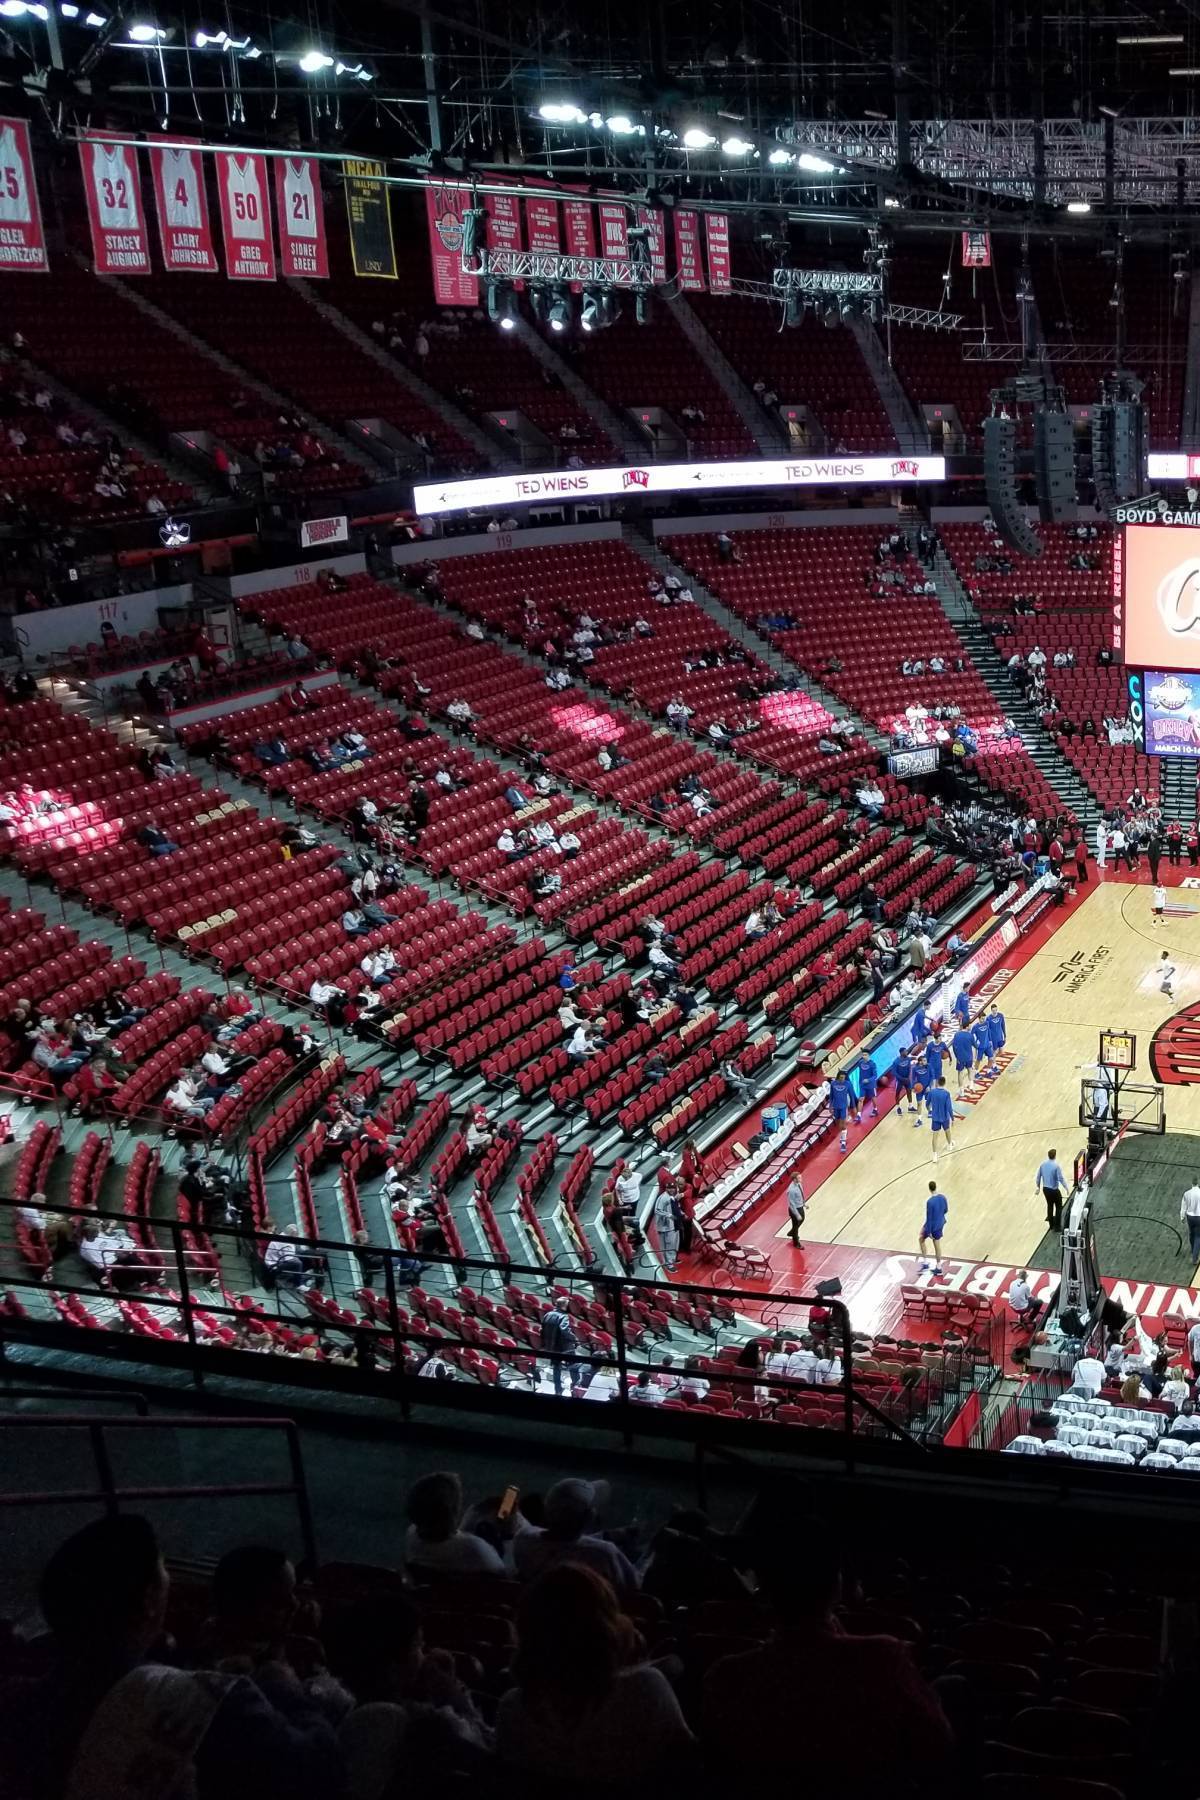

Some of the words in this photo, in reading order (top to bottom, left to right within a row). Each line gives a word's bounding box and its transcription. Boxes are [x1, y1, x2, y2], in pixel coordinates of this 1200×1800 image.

[346, 160, 382, 177] NCAA
[0, 167, 19, 199] 5
[102, 178, 129, 209] 32
[174, 178, 188, 207] 4
[234, 192, 258, 220] 50
[292, 192, 310, 220] 21
[105, 234, 141, 251] STACEY
[172, 232, 200, 249] LARRY
[106, 250, 147, 267] AUGMON
[171, 248, 210, 265] JOHNSON
[240, 245, 261, 261] GREG
[290, 242, 317, 258] SIDNEY
[234, 260, 270, 276] ANTHONY
[293, 258, 318, 273] GREEN
[785, 465, 812, 481] TED
[814, 463, 865, 477] WIENS
[515, 481, 541, 498] TED
[541, 476, 589, 493] WIENS
[767, 515, 785, 527] 120
[1116, 509, 1157, 524] BOYD
[496, 534, 512, 549] 119
[293, 567, 310, 583] 118
[98, 602, 118, 619] 117
[1113, 604, 1122, 619] A
[1113, 625, 1122, 648] BE
[1128, 675, 1144, 744] COX
[1154, 744, 1181, 754] MARCH
[1064, 964, 1099, 994] AMERICA
[1088, 944, 1112, 964] FIRST
